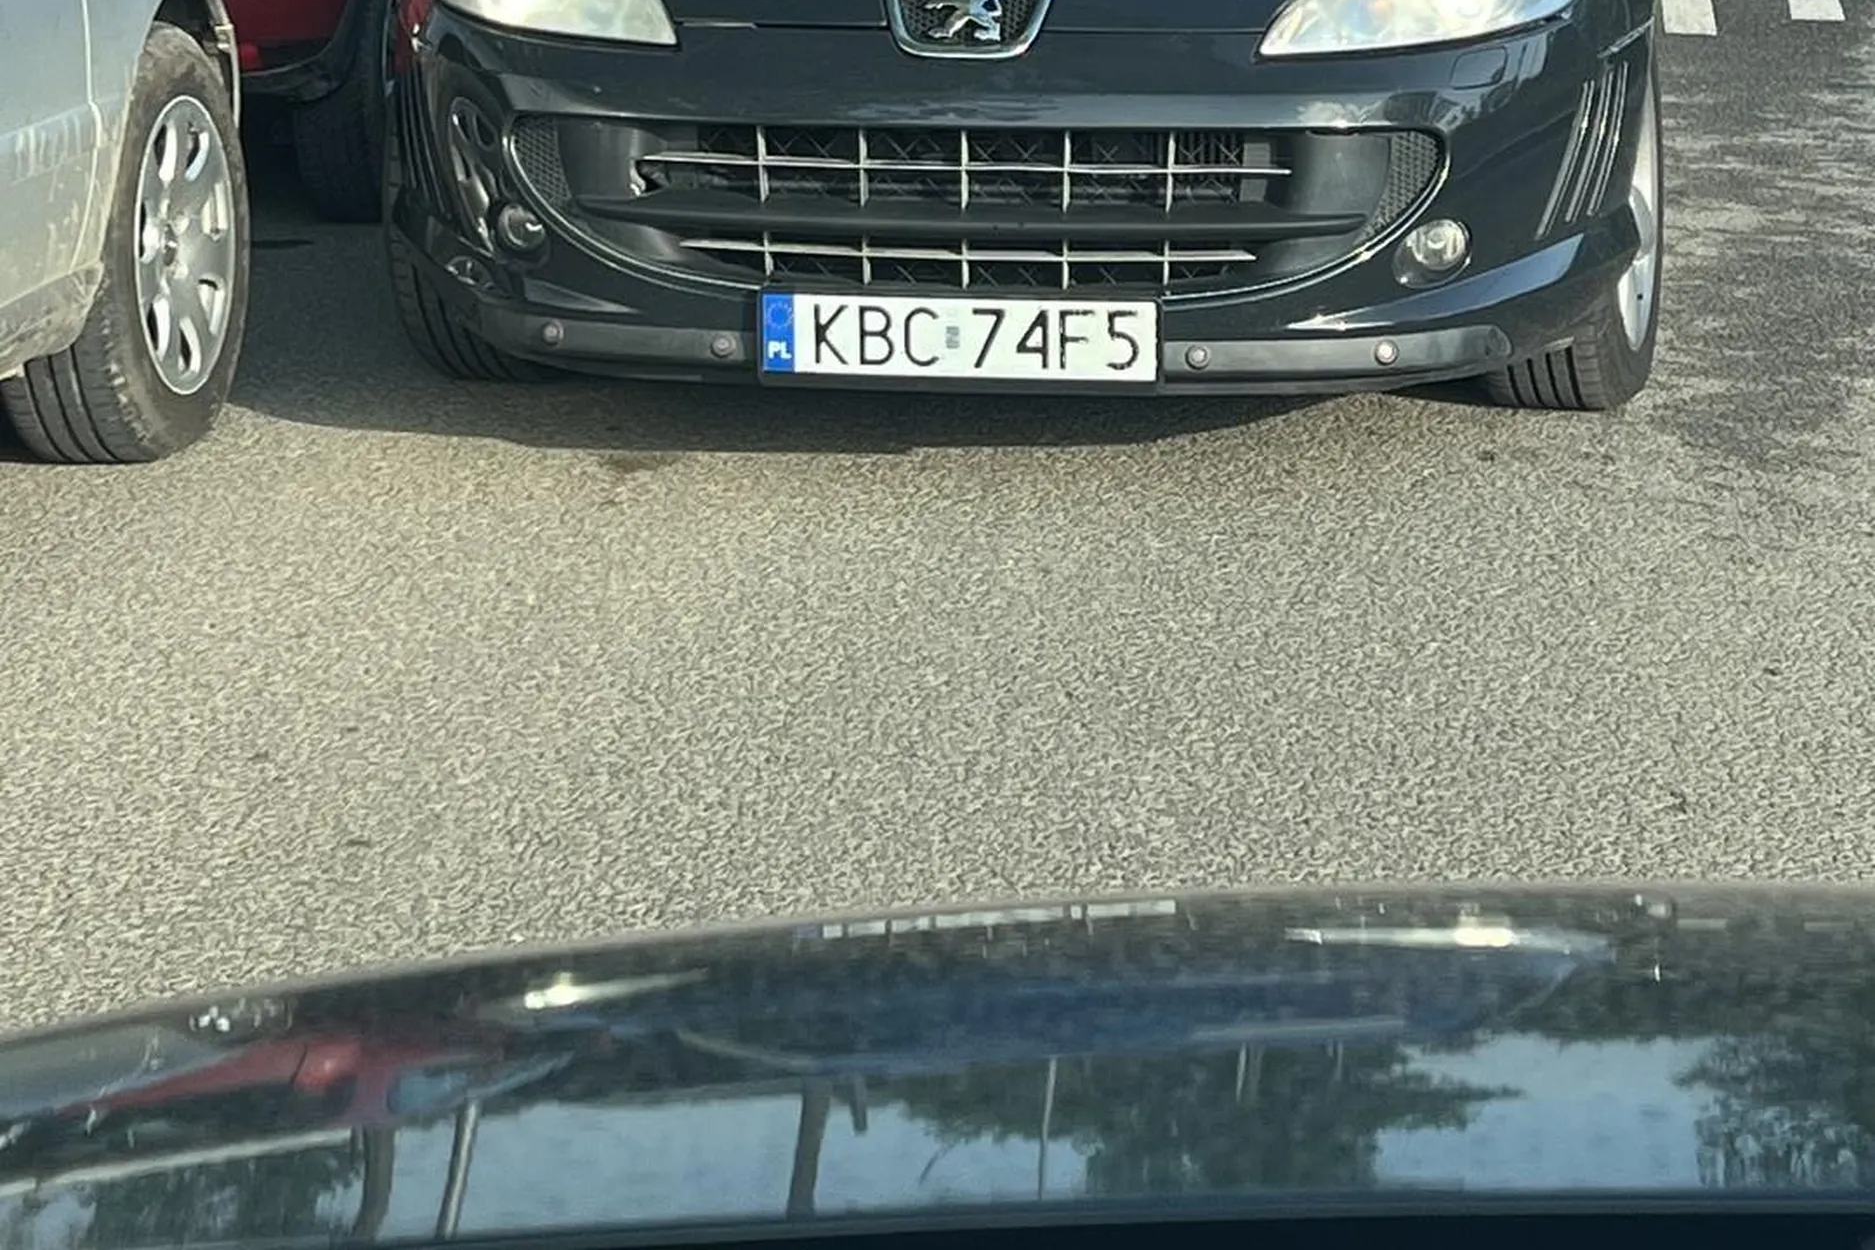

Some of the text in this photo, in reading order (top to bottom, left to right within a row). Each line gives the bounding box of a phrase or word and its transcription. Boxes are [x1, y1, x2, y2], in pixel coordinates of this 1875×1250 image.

[768, 341, 792, 359] PL
[813, 304, 1139, 371] KBC 74F5
